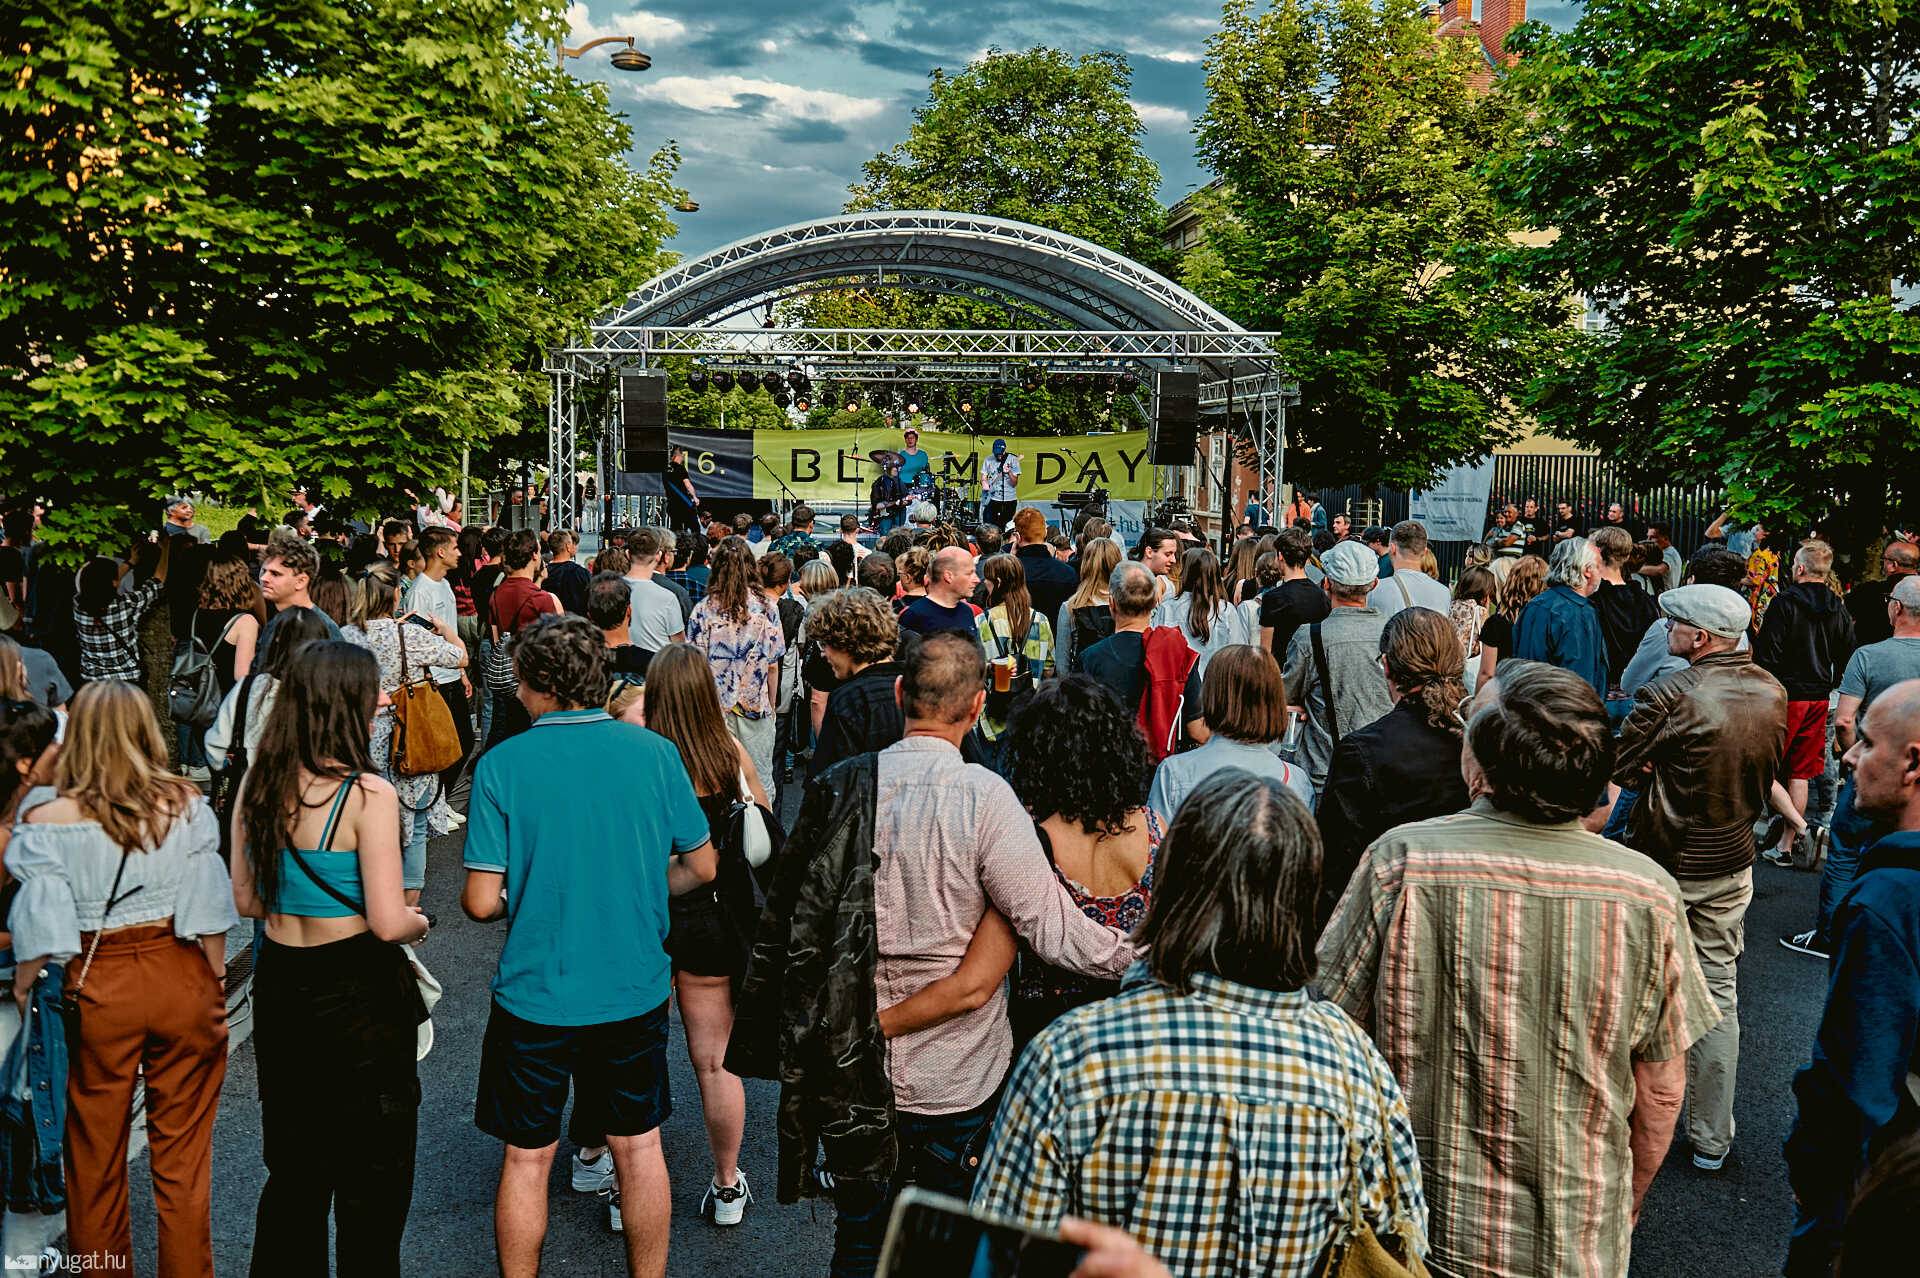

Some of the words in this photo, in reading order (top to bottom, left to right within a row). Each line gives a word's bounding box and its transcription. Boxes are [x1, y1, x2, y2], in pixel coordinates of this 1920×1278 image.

[682, 450, 725, 475] 16.
[791, 448, 978, 485] BLM
[1035, 449, 1148, 485] DAY
